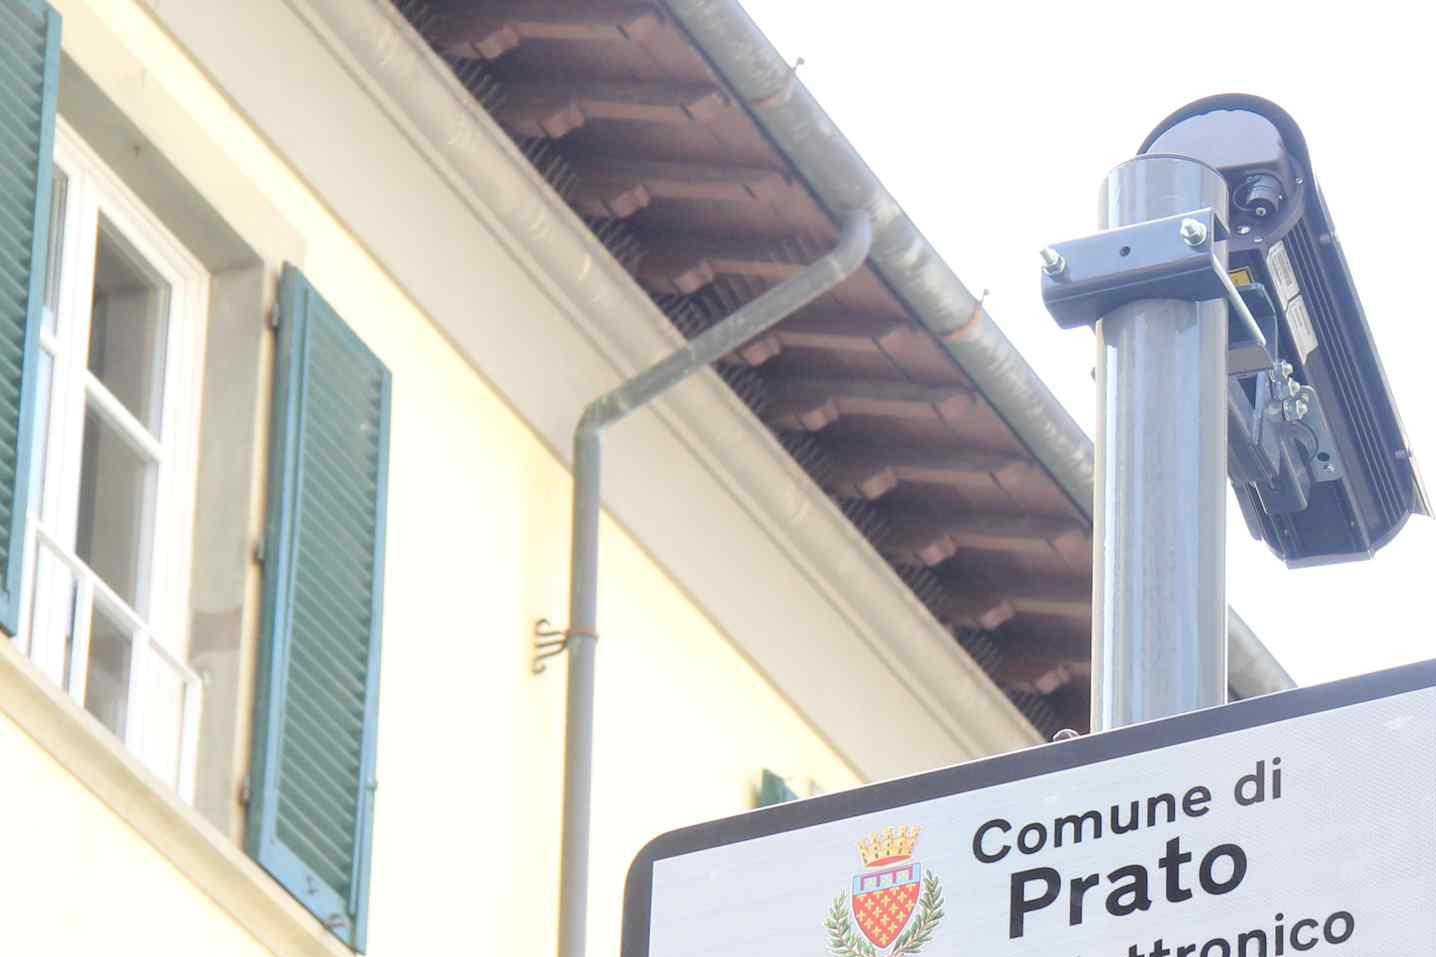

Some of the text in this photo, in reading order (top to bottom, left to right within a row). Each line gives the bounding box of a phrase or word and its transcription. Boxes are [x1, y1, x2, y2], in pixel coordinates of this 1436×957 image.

[972, 757, 1283, 864] Comune di
[1008, 835, 1249, 940] Prato
